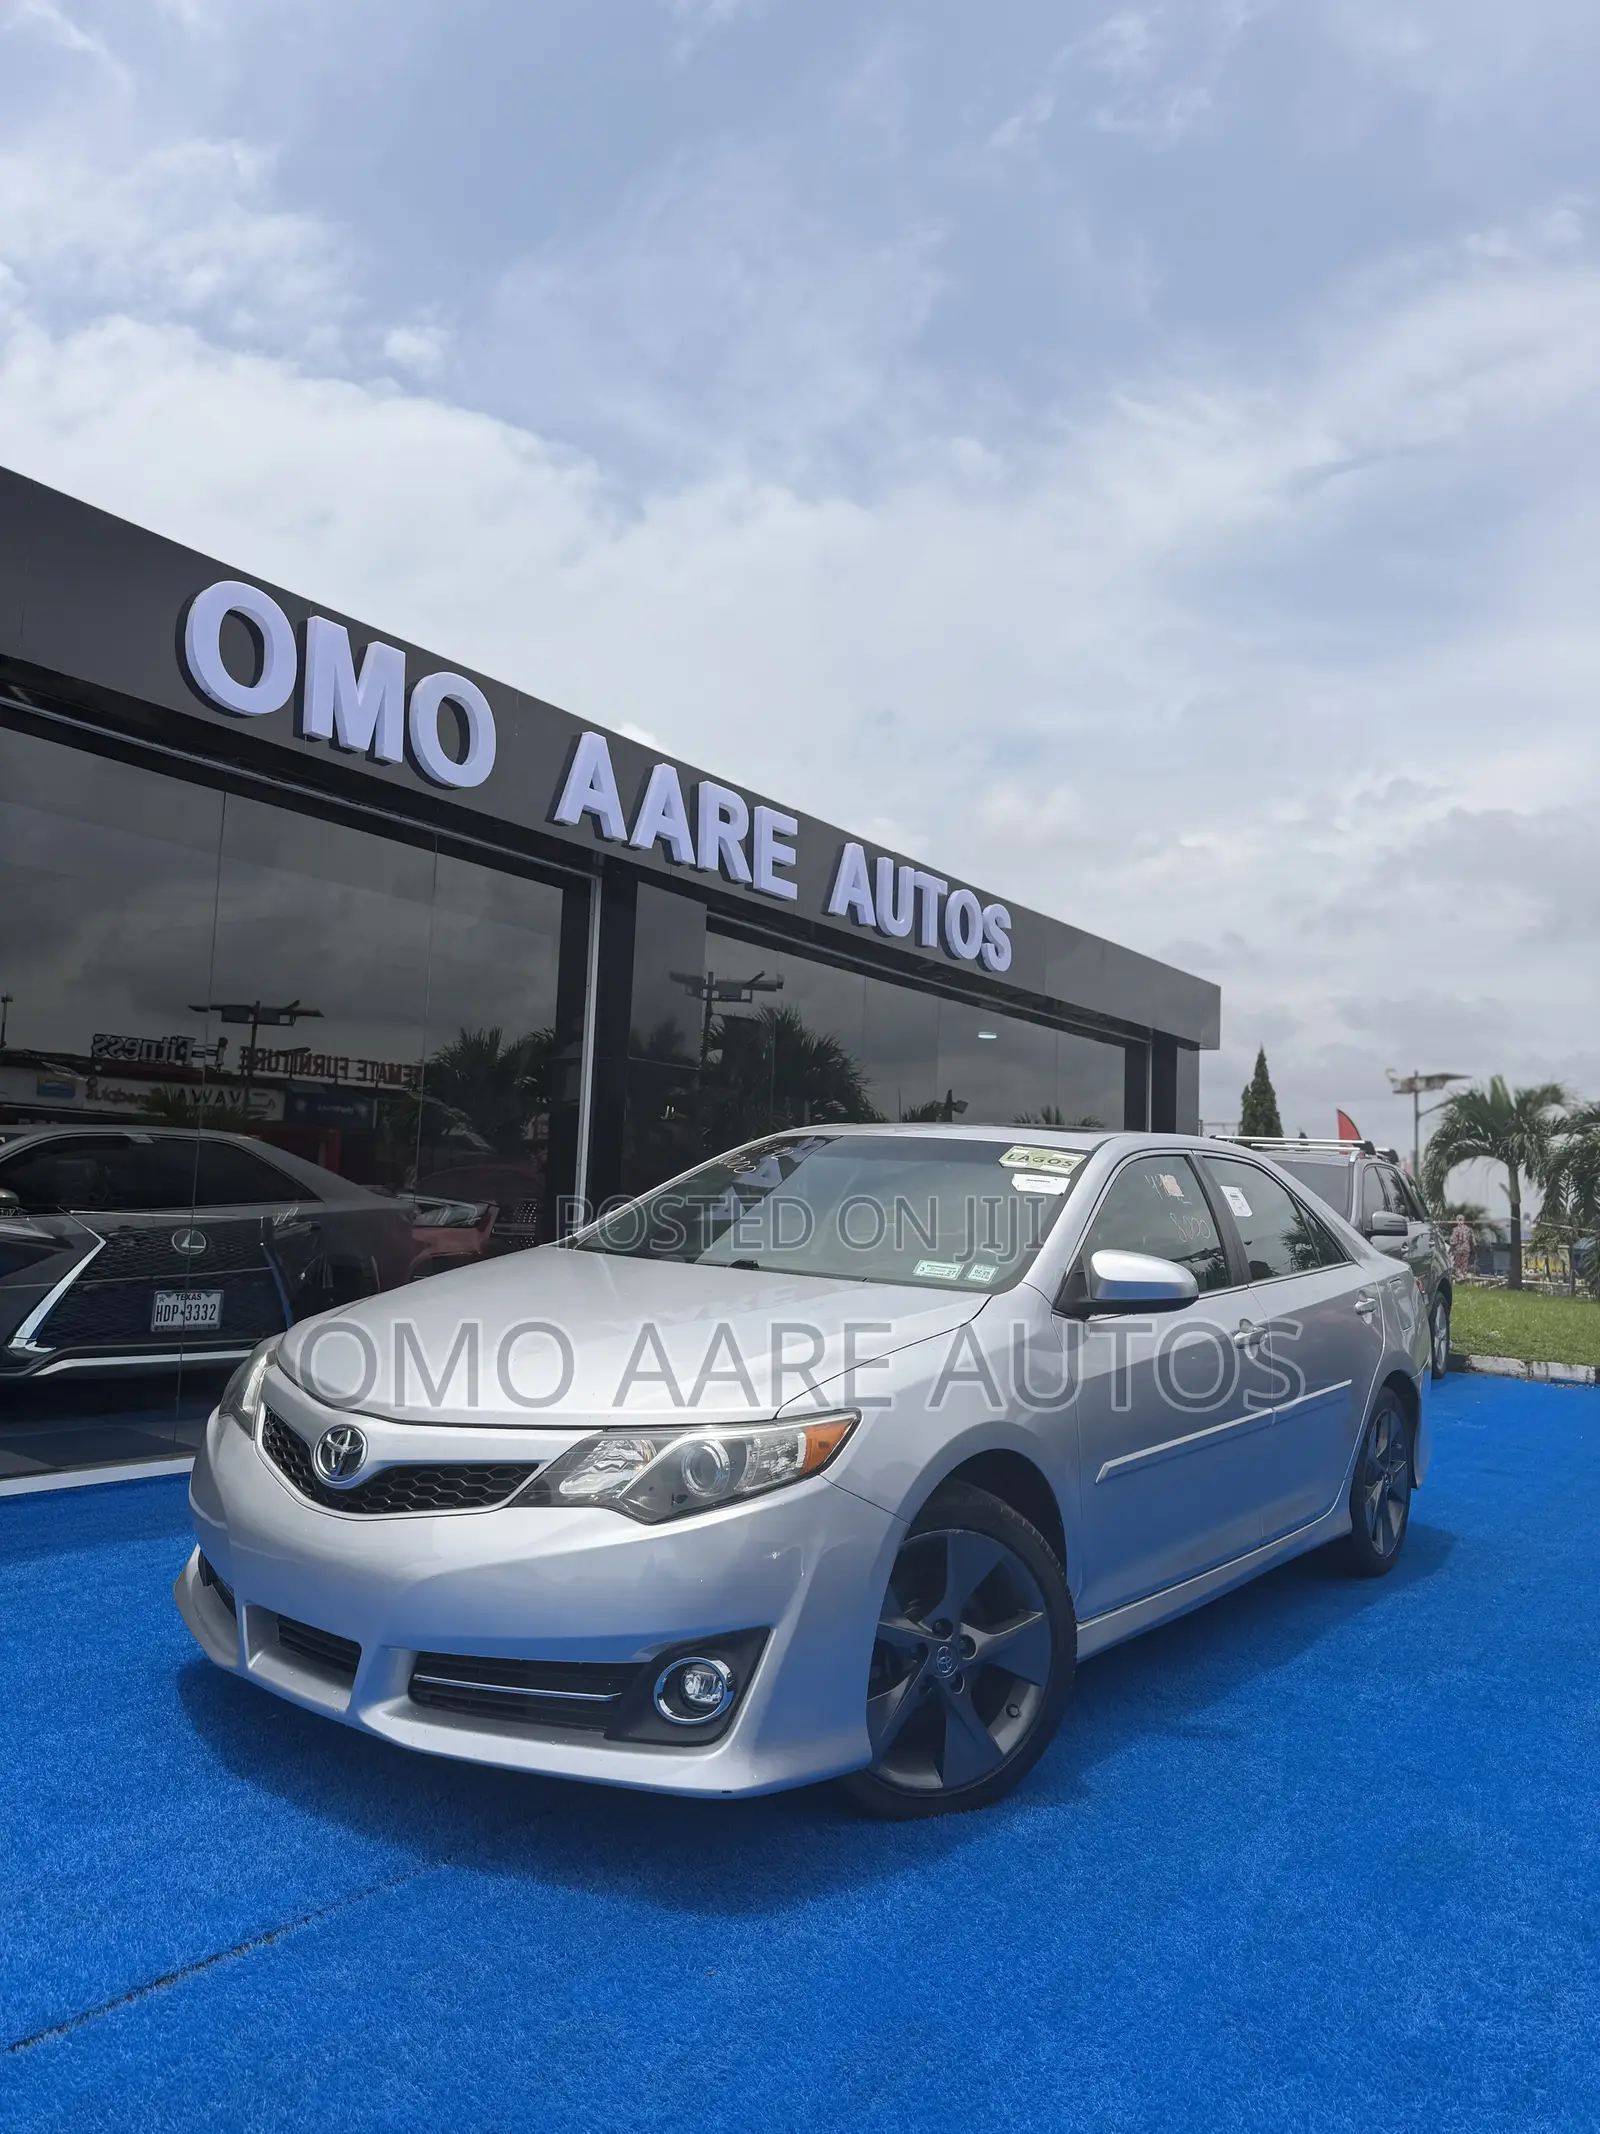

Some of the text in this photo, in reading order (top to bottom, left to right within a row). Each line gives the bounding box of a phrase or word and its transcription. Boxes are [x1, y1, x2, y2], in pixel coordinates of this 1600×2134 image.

[183, 580, 1012, 972] OMO AARE AUTOS
[1006, 1153, 1074, 1167] LAGOS
[176, 1293, 202, 1301] TEXAS
